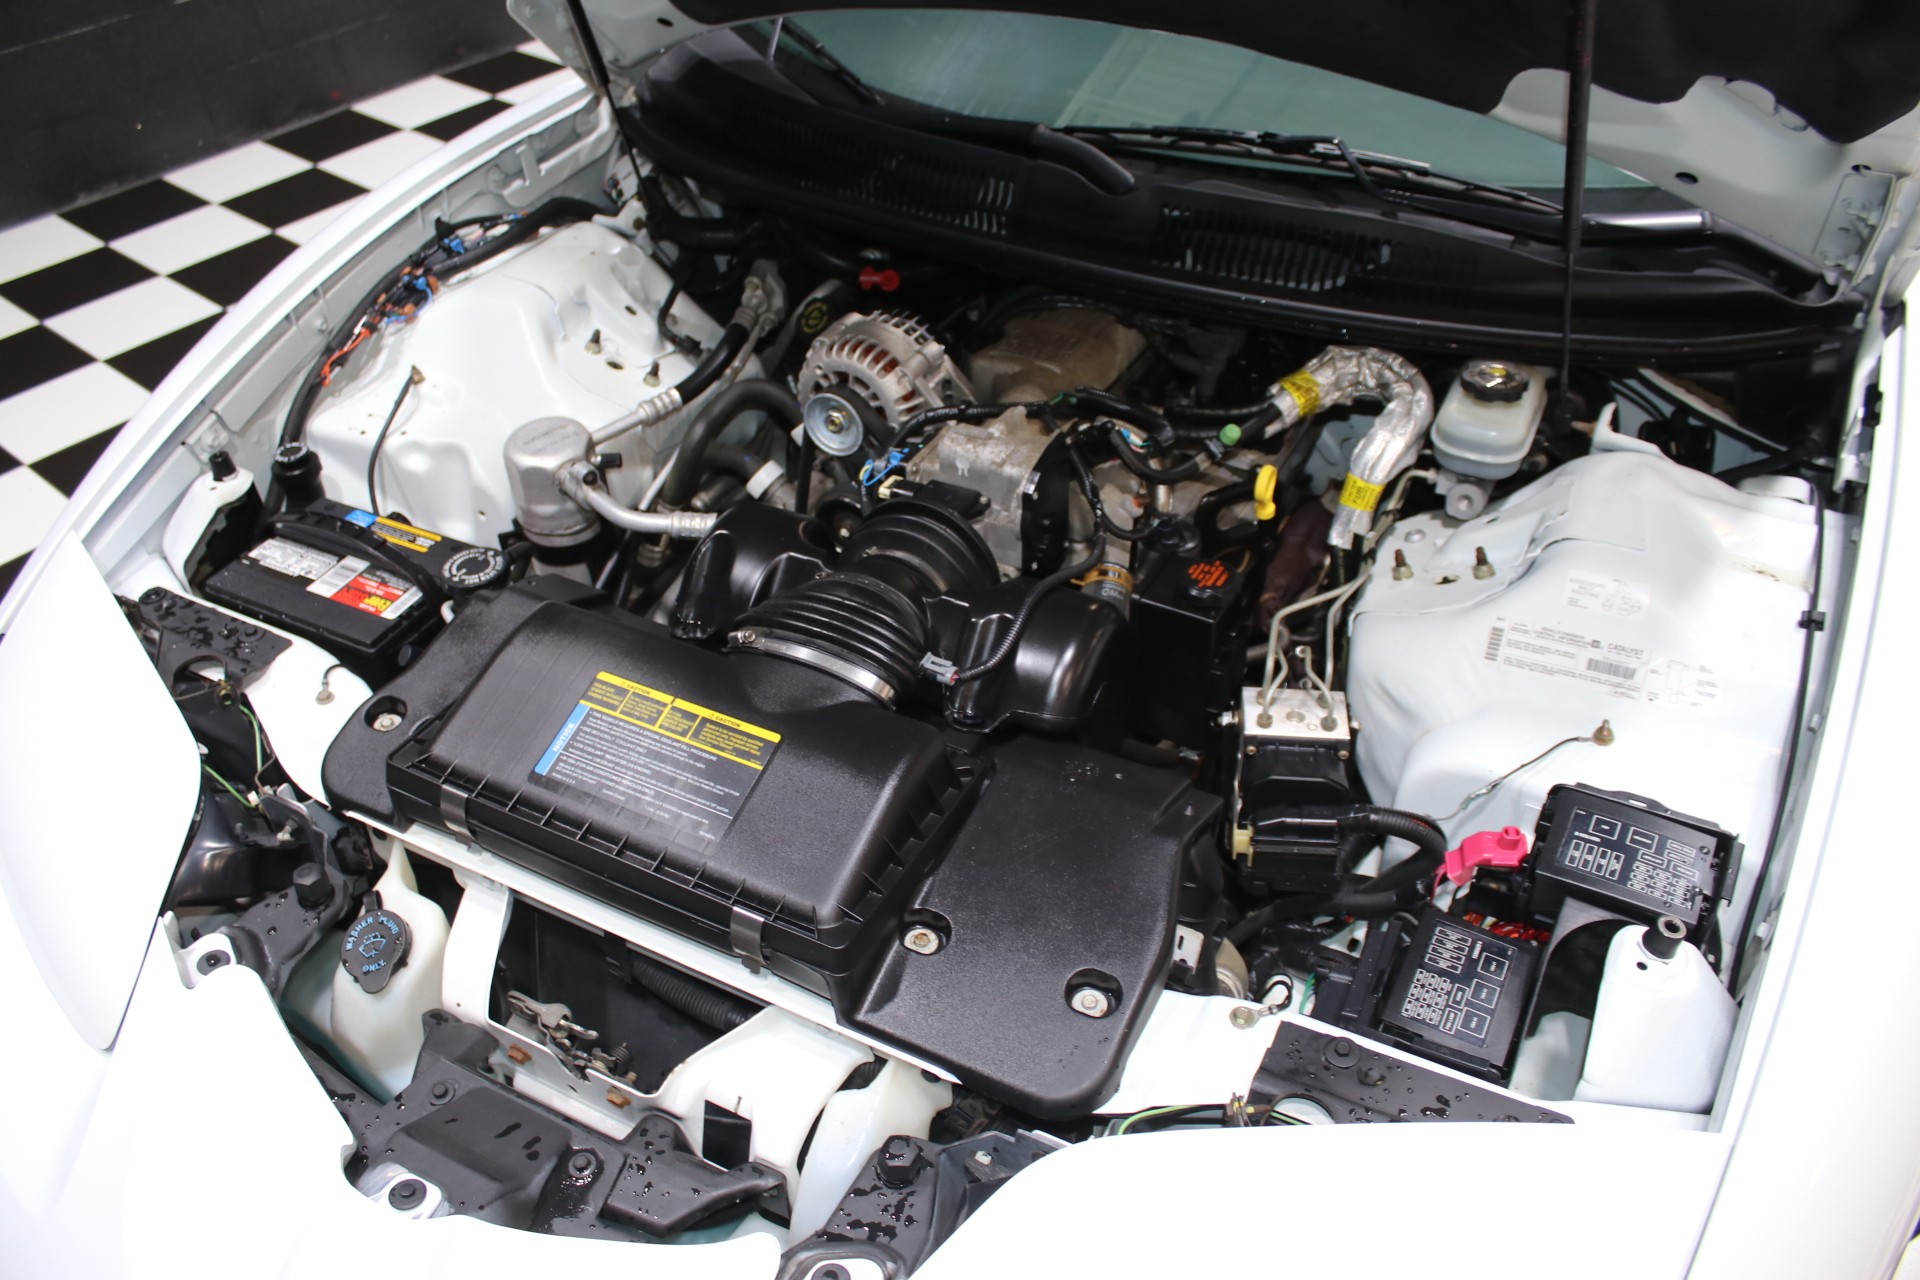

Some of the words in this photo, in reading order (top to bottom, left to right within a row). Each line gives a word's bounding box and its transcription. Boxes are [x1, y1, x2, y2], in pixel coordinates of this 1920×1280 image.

[1607, 642, 1644, 656] CATALYST
[626, 685, 650, 694] CAUTION
[715, 716, 740, 726] CAUTION
[551, 721, 575, 753] NOTICE
[379, 916, 398, 934] FLUID
[363, 959, 385, 972] ONLY
